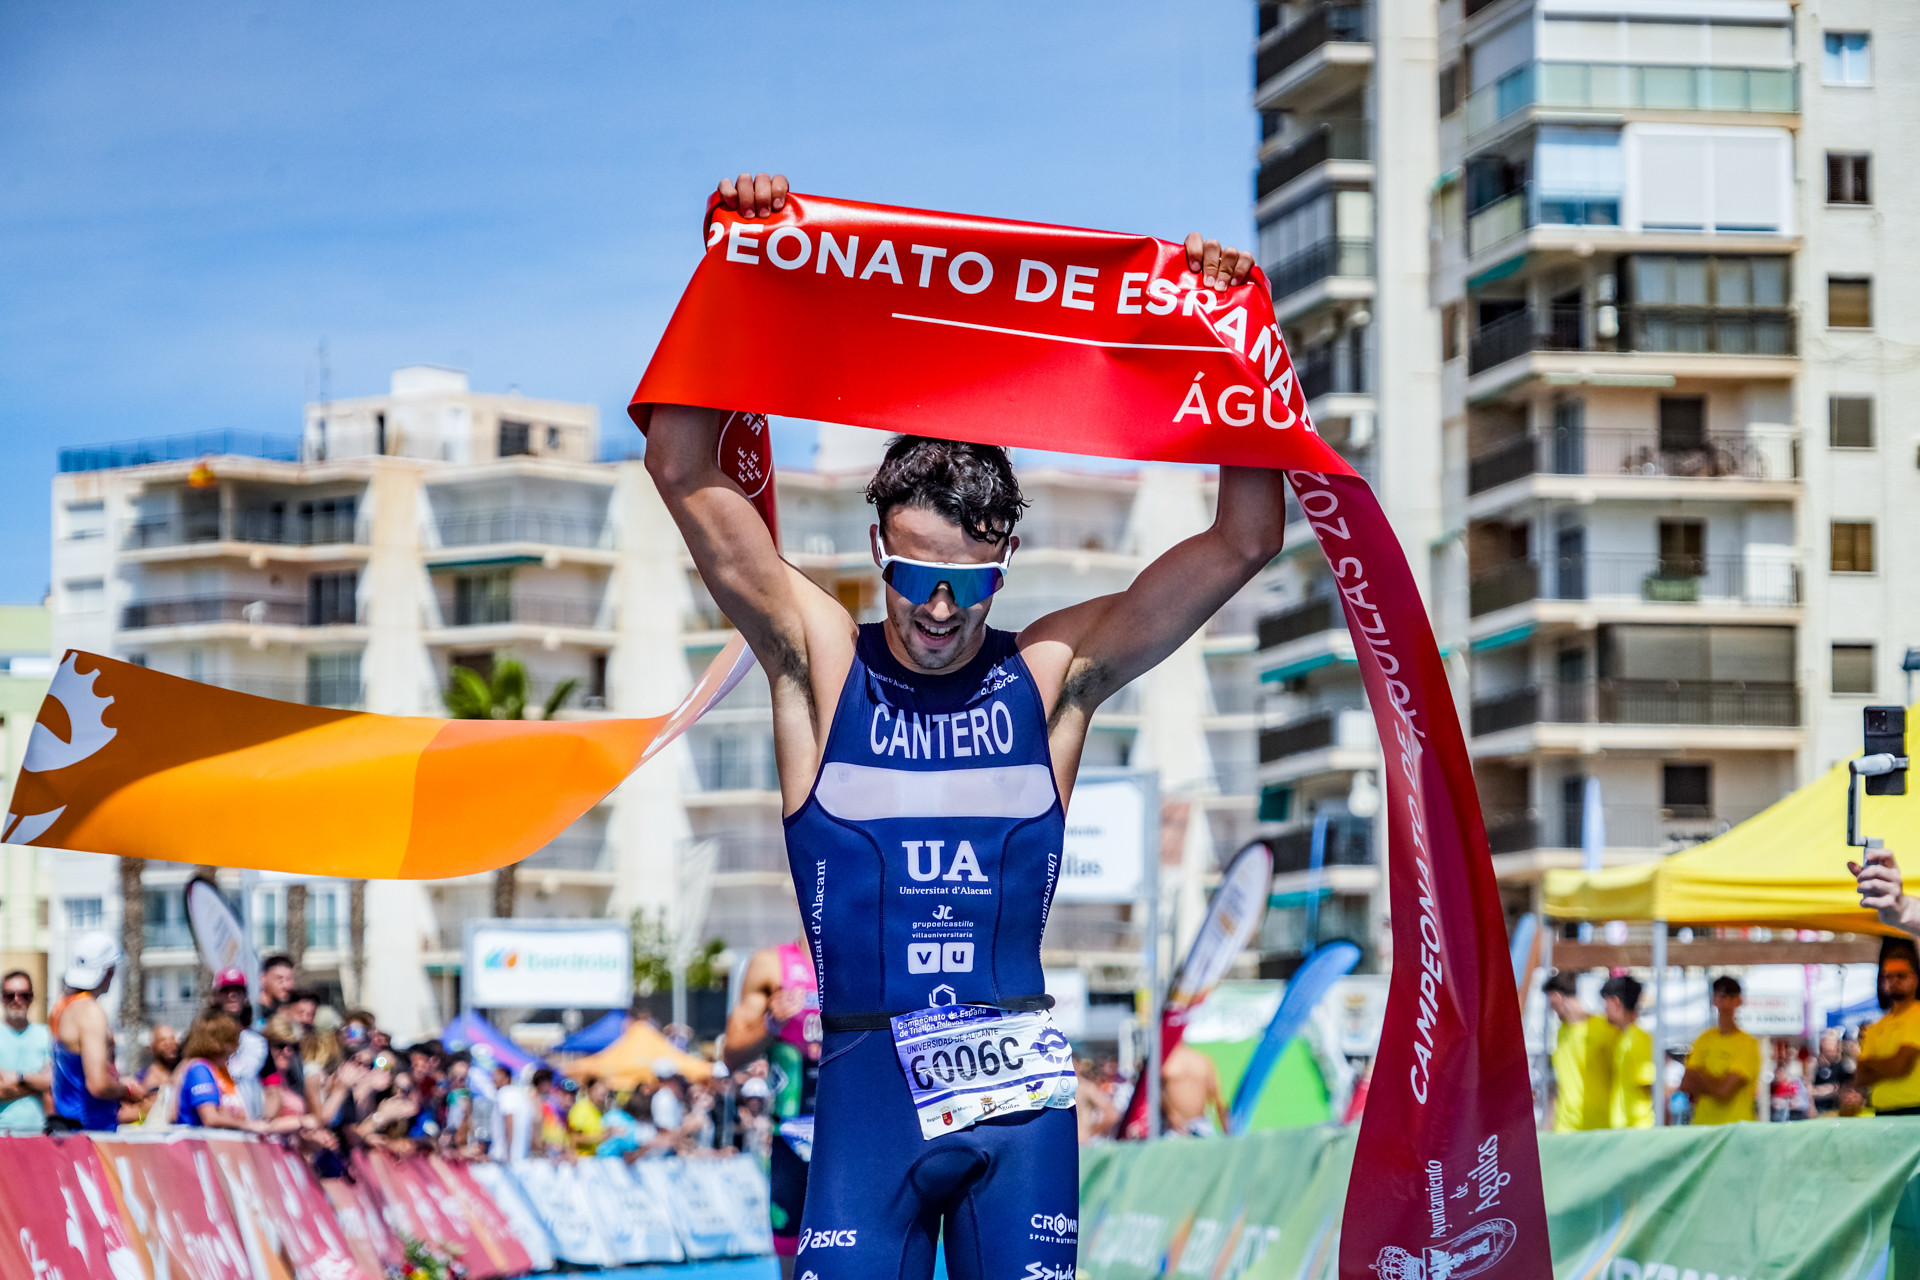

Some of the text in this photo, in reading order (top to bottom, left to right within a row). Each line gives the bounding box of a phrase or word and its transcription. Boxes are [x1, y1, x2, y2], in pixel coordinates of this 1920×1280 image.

[1015, 259, 1099, 311] DE
[1116, 272, 1293, 407] ESPAÑA
[870, 700, 1014, 760] CANTERO
[901, 840, 989, 882] UA
[811, 858, 827, 936] d'Alacant
[899, 886, 993, 896] Universitat d'Alacant
[912, 920, 974, 929] grupoelcastillo
[1408, 794, 1443, 1105] CAMPEONATO
[897, 1014, 946, 1030] Campeonato
[906, 1036, 956, 1055] UNIVERSIDAD
[965, 1028, 999, 1041] ALICANTE
[910, 1036, 1024, 1090] 6006C
[1449, 1182, 1469, 1199] de
[1468, 1134, 1511, 1215] Águilas
[1425, 1159, 1453, 1238] Ayuntamiento
[1029, 1233, 1055, 1243] SPORT
[1030, 1212, 1078, 1237] CROWN
